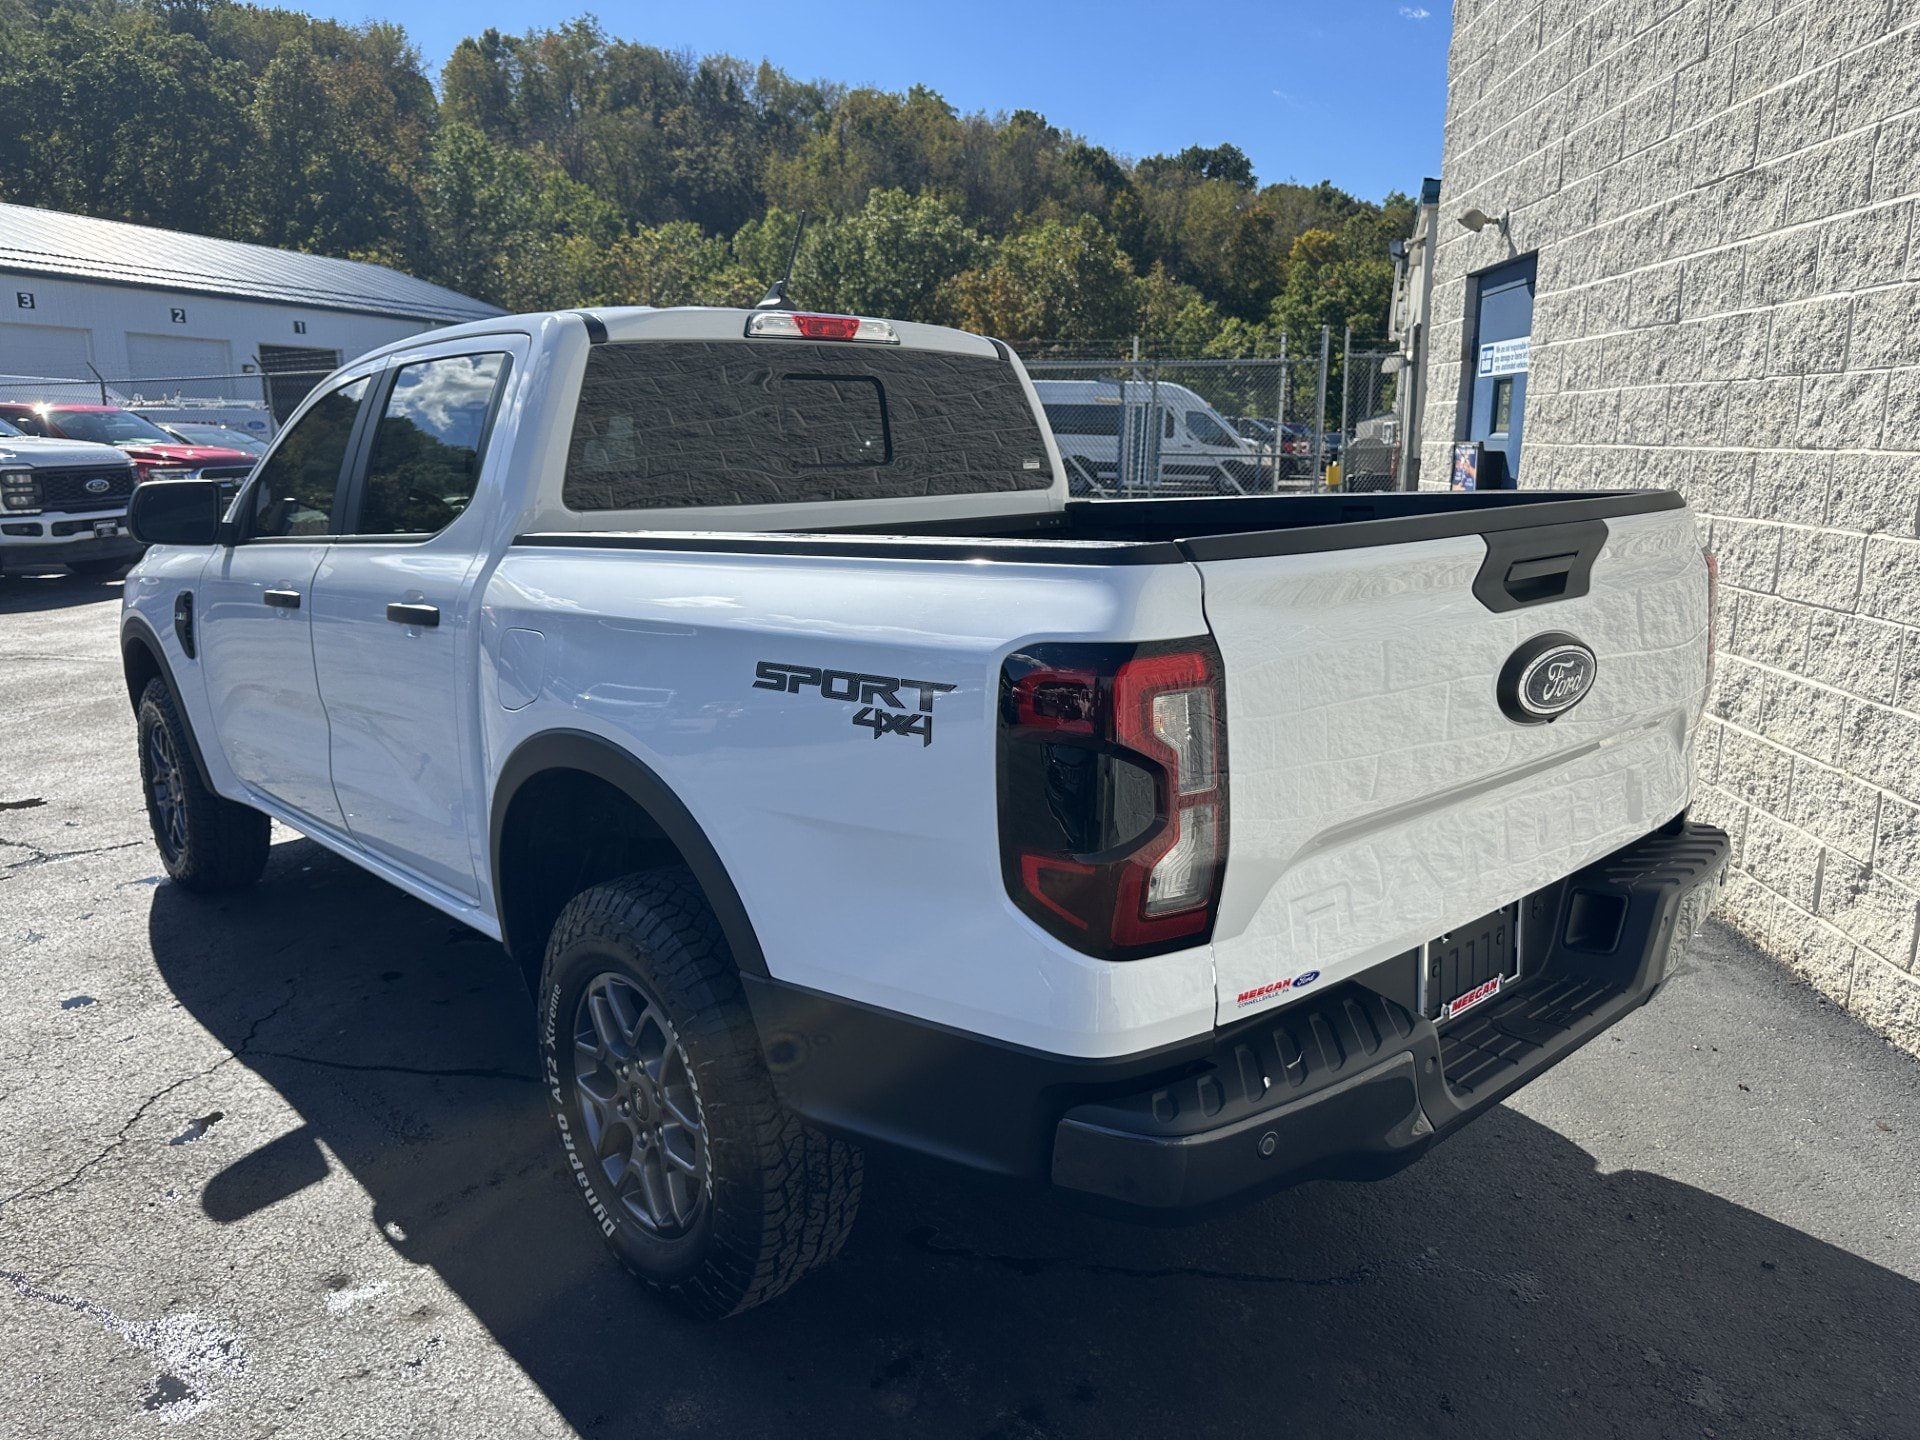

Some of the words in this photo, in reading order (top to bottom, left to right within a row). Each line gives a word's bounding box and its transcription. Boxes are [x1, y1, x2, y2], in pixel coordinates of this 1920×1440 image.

[20, 293, 33, 308] 3
[173, 309, 184, 323] 2
[297, 321, 305, 334] 1
[752, 661, 957, 713] SPORT
[1543, 660, 1584, 701] Ford
[852, 707, 932, 748] 4x4
[1237, 978, 1292, 1003] MEEGAN
[1451, 979, 1498, 1012] MEEGAN
[545, 983, 562, 1050] Xtreme
[546, 1056, 564, 1105] AT2
